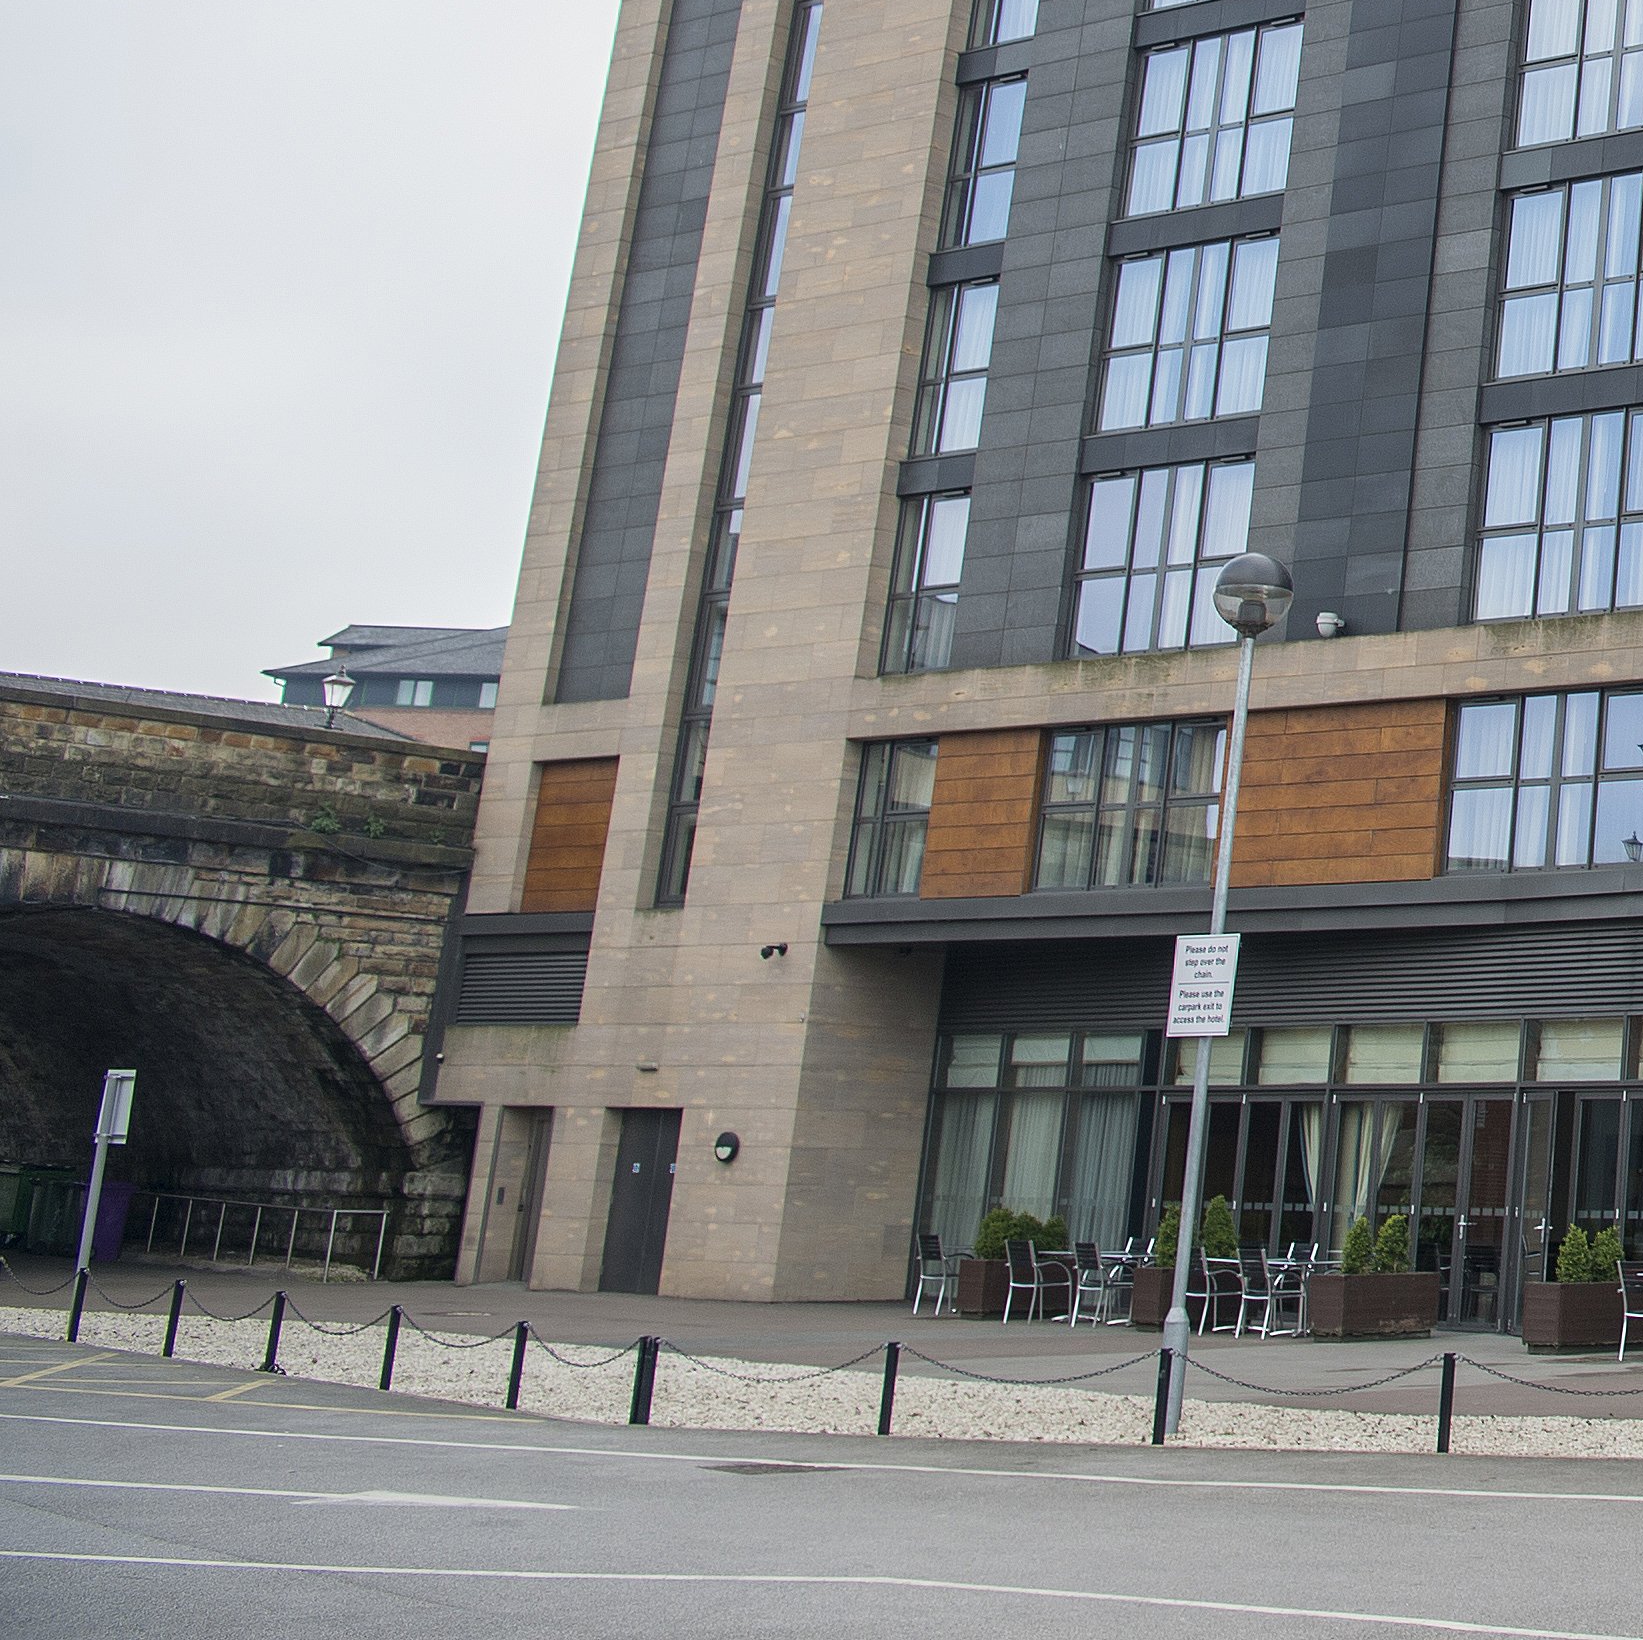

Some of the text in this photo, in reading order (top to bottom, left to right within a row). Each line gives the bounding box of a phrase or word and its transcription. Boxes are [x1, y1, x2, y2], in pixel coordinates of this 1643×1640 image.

[1185, 945, 1229, 954] Please do not
[1185, 959, 1199, 968] step
[1215, 958, 1226, 966] the
[1179, 990, 1200, 999] Please
[1213, 990, 1225, 998] the
[1178, 1003, 1202, 1012] carpark
[1195, 1016, 1206, 1024] the
